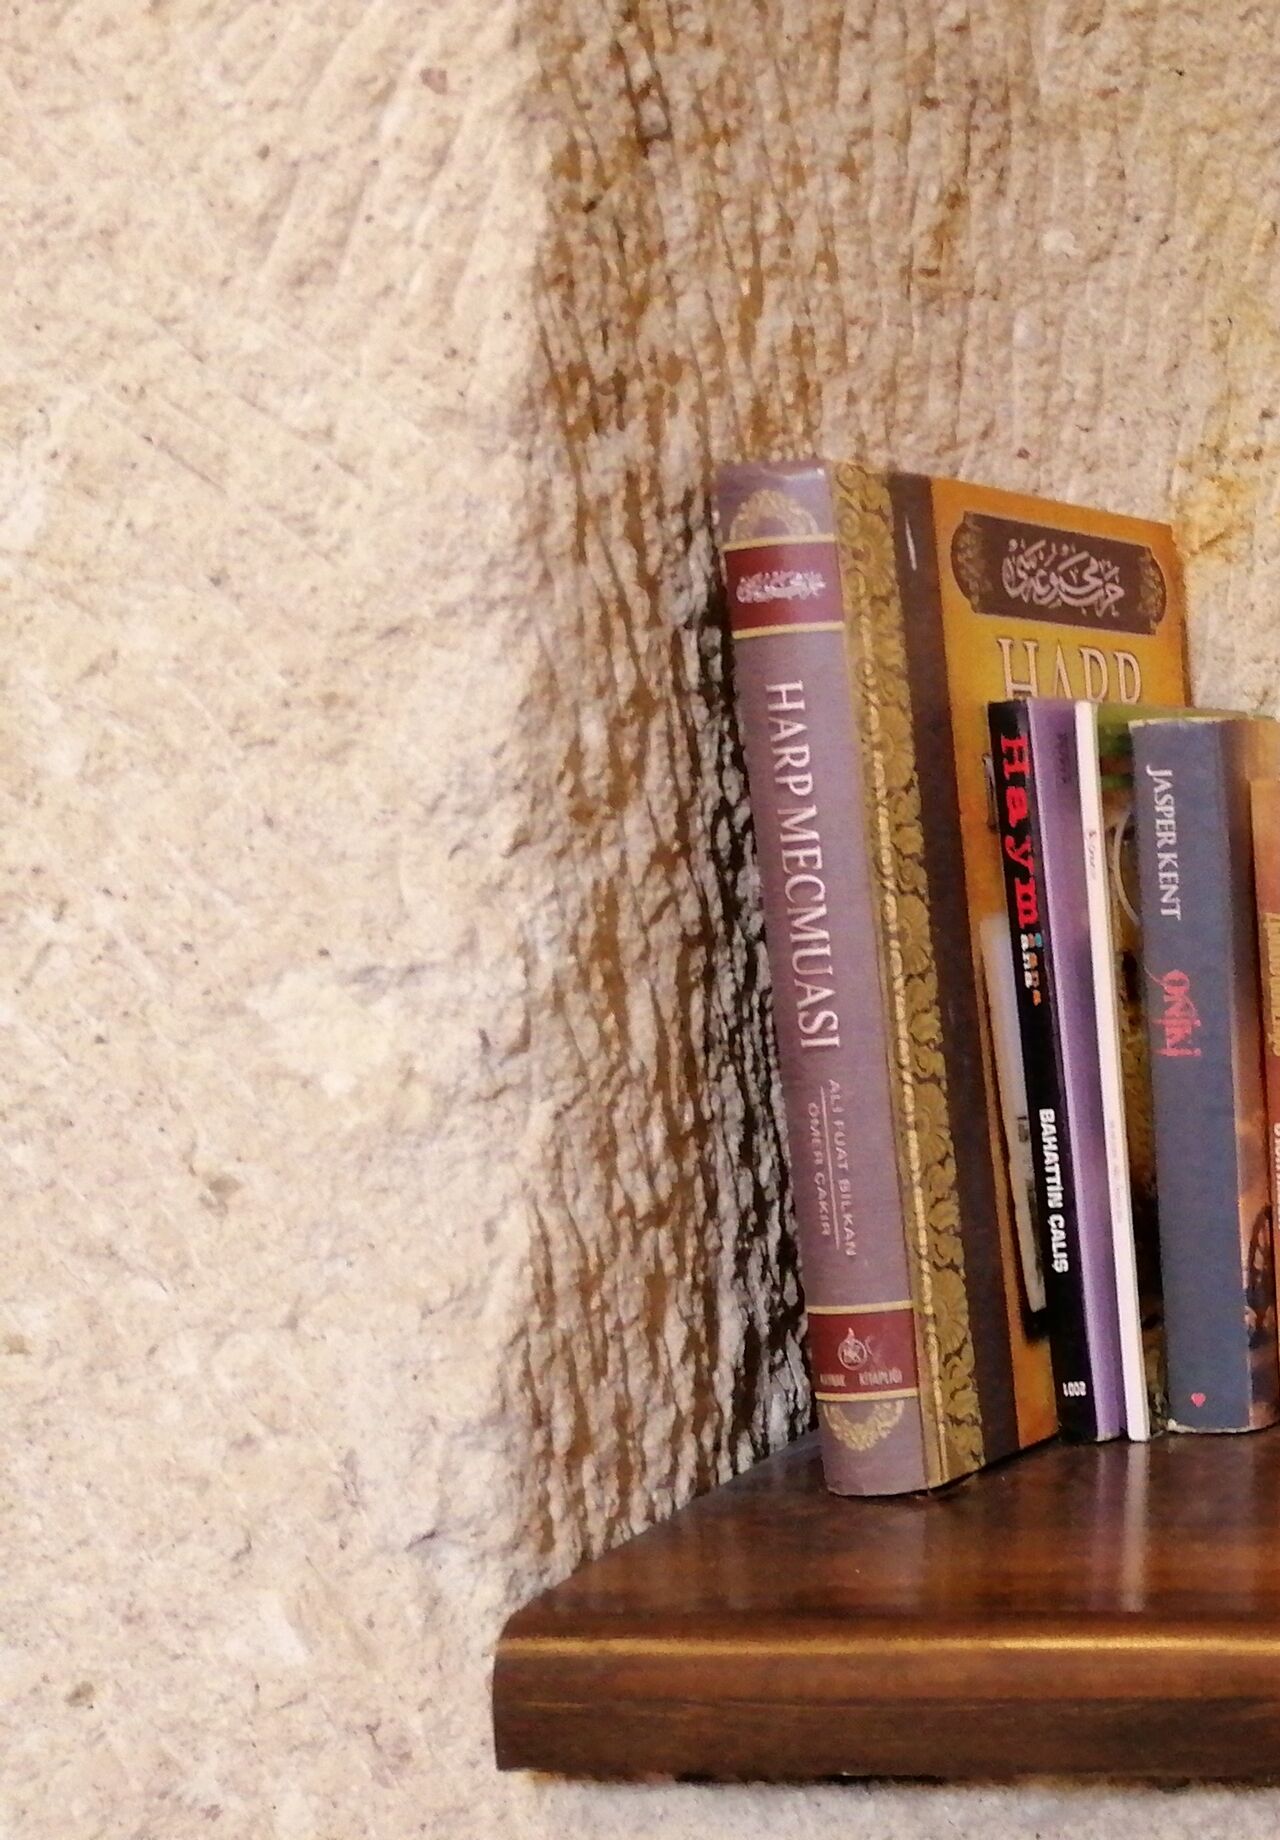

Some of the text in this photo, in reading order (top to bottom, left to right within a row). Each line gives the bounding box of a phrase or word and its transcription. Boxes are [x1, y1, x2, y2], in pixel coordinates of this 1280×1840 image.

[766, 680, 840, 1050] HARP MECMUASI
[1146, 765, 1181, 920] JASPER KENT
[1039, 1109, 1069, 1273] BAHATTİN ÇALIŞ
